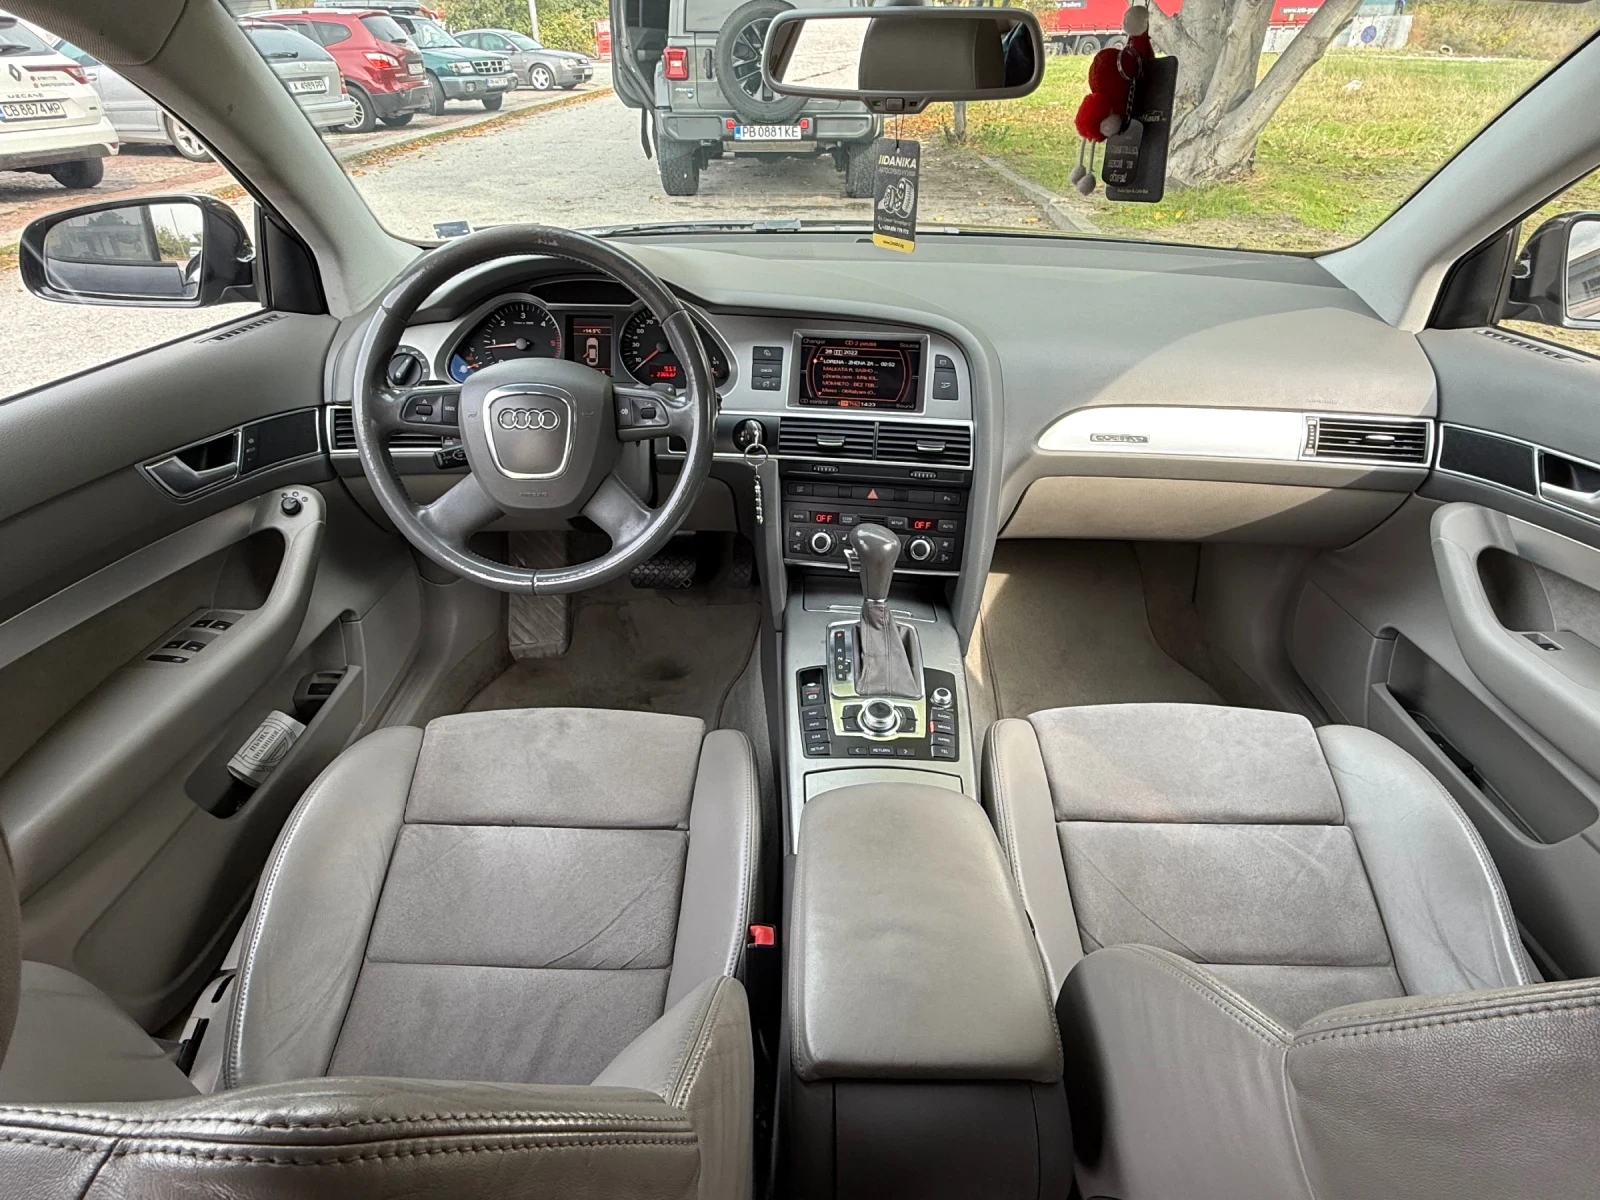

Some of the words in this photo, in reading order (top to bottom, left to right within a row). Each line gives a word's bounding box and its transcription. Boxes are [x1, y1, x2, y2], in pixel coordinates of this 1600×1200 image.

[742, 126, 756, 137] PB
[758, 126, 782, 137] 0881
[784, 126, 798, 137] KE
[816, 514, 833, 523] OFF
[914, 521, 932, 530] OFF
[253, 730, 279, 759] ПОЛИЦИЯ
